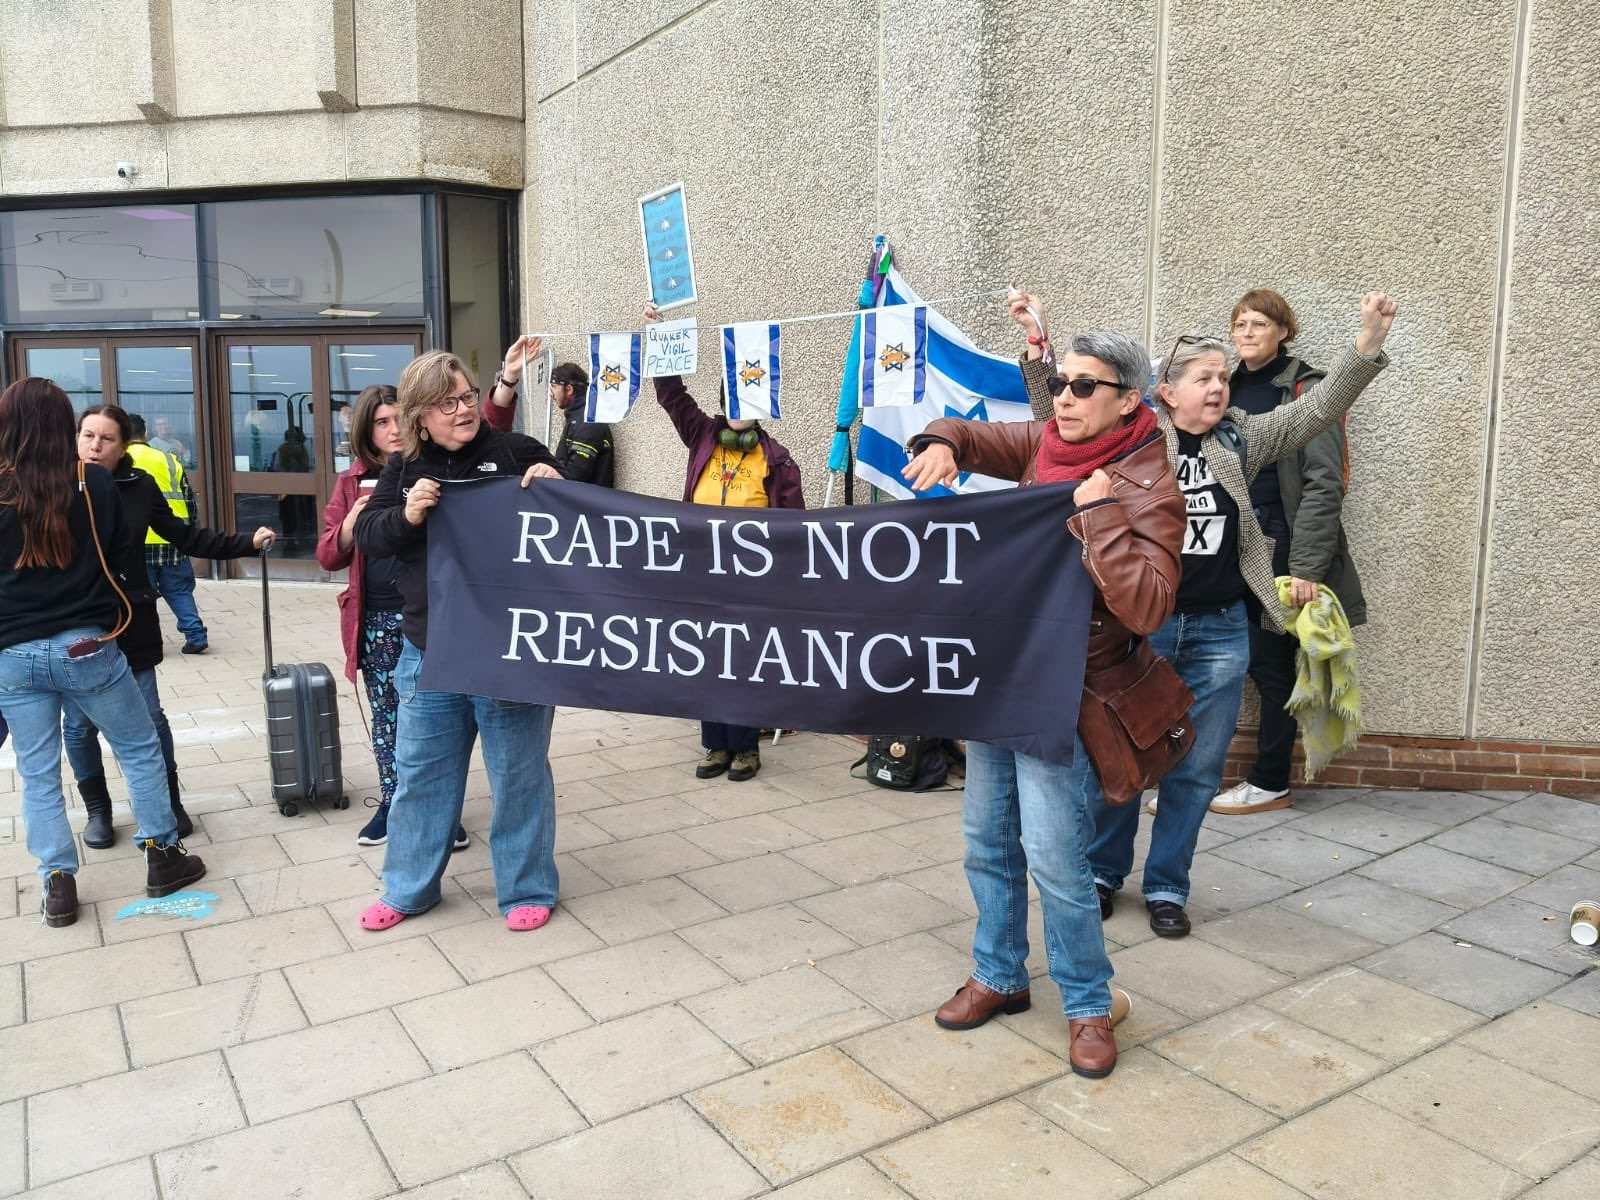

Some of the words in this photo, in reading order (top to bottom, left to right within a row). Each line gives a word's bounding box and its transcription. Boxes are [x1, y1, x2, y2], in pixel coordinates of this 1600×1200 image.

[650, 328, 690, 342] QUAKER
[646, 354, 694, 376] PEACE
[512, 511, 684, 572] RAPE
[707, 519, 774, 577] IS
[801, 520, 981, 585] NOT
[501, 607, 980, 696] RESISTANCE
